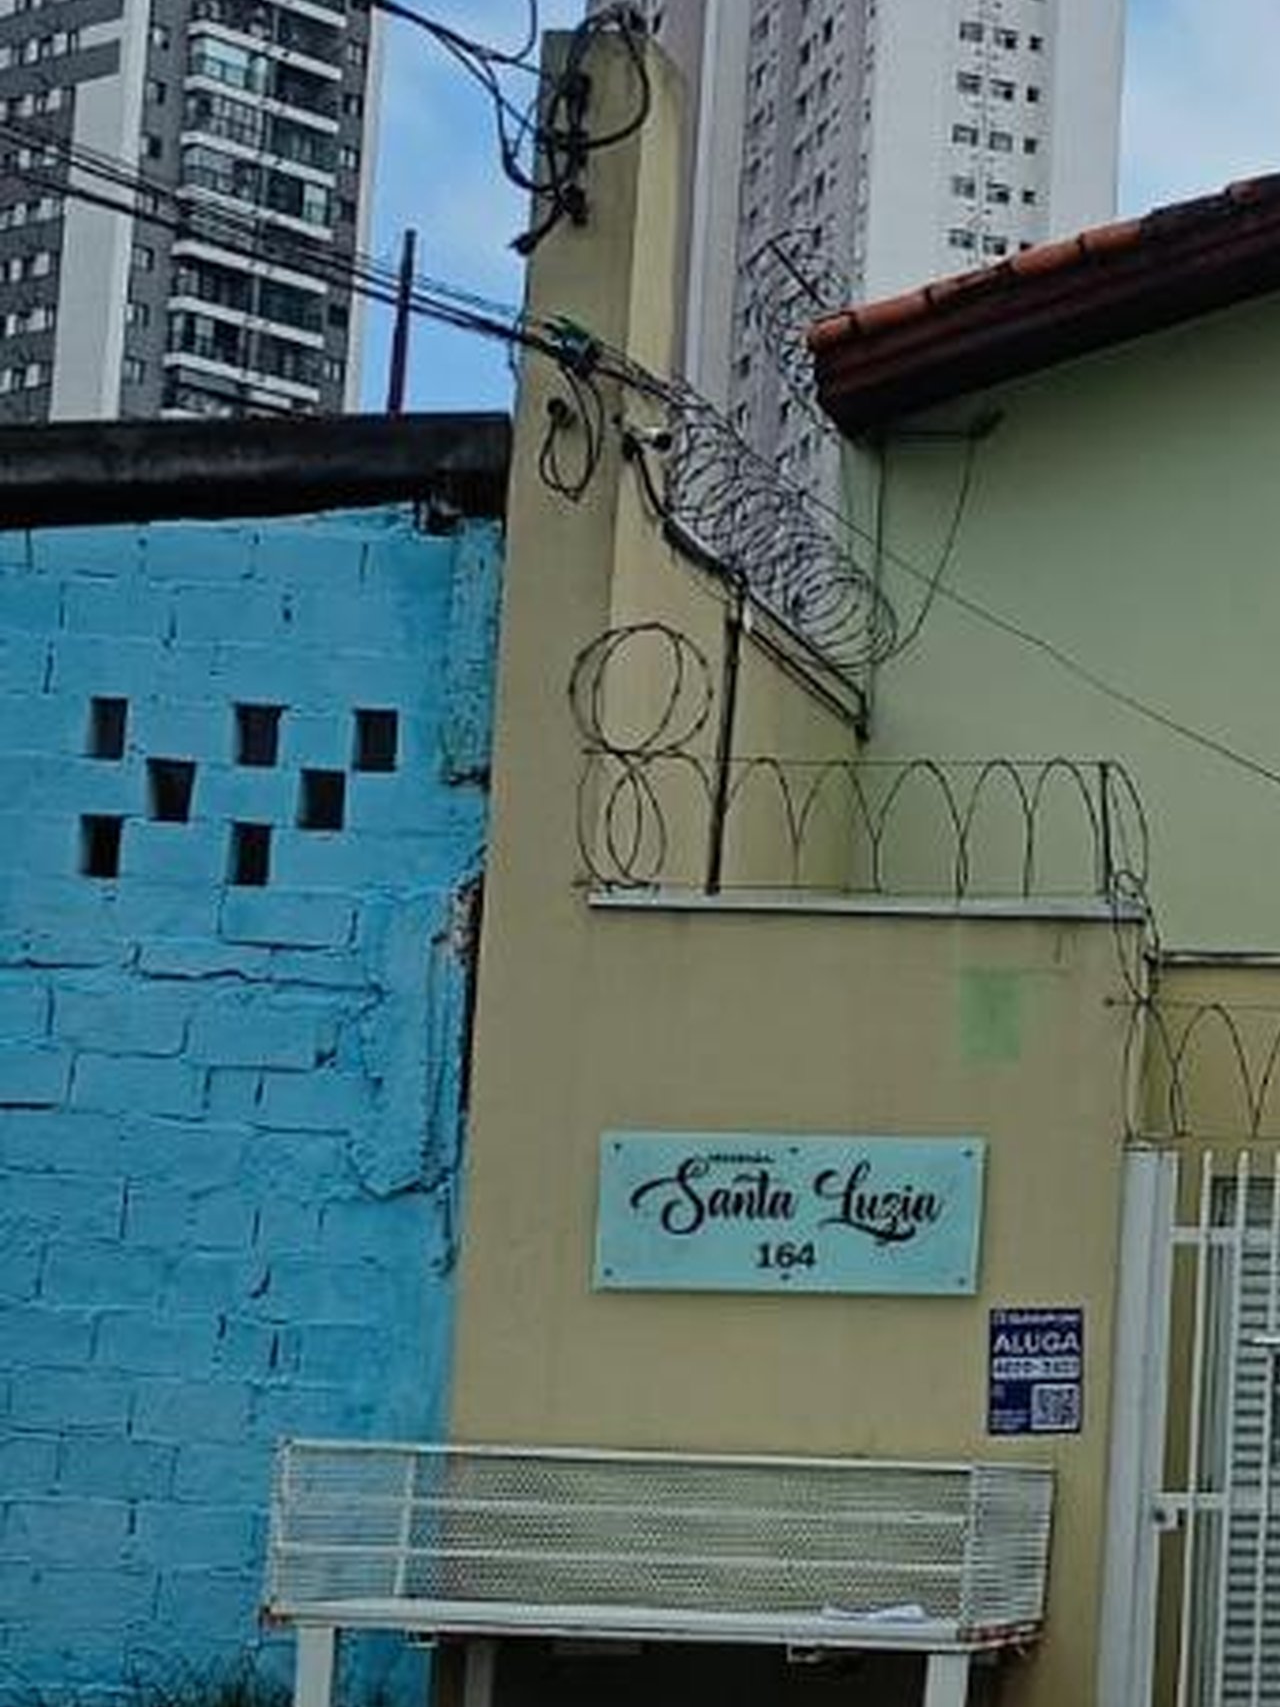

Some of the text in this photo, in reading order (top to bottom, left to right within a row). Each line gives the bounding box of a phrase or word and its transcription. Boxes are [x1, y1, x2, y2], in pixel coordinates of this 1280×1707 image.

[630, 1157, 943, 1246] Santa Luzia
[757, 1241, 816, 1270] 164
[993, 1332, 1081, 1354] ALUGA
